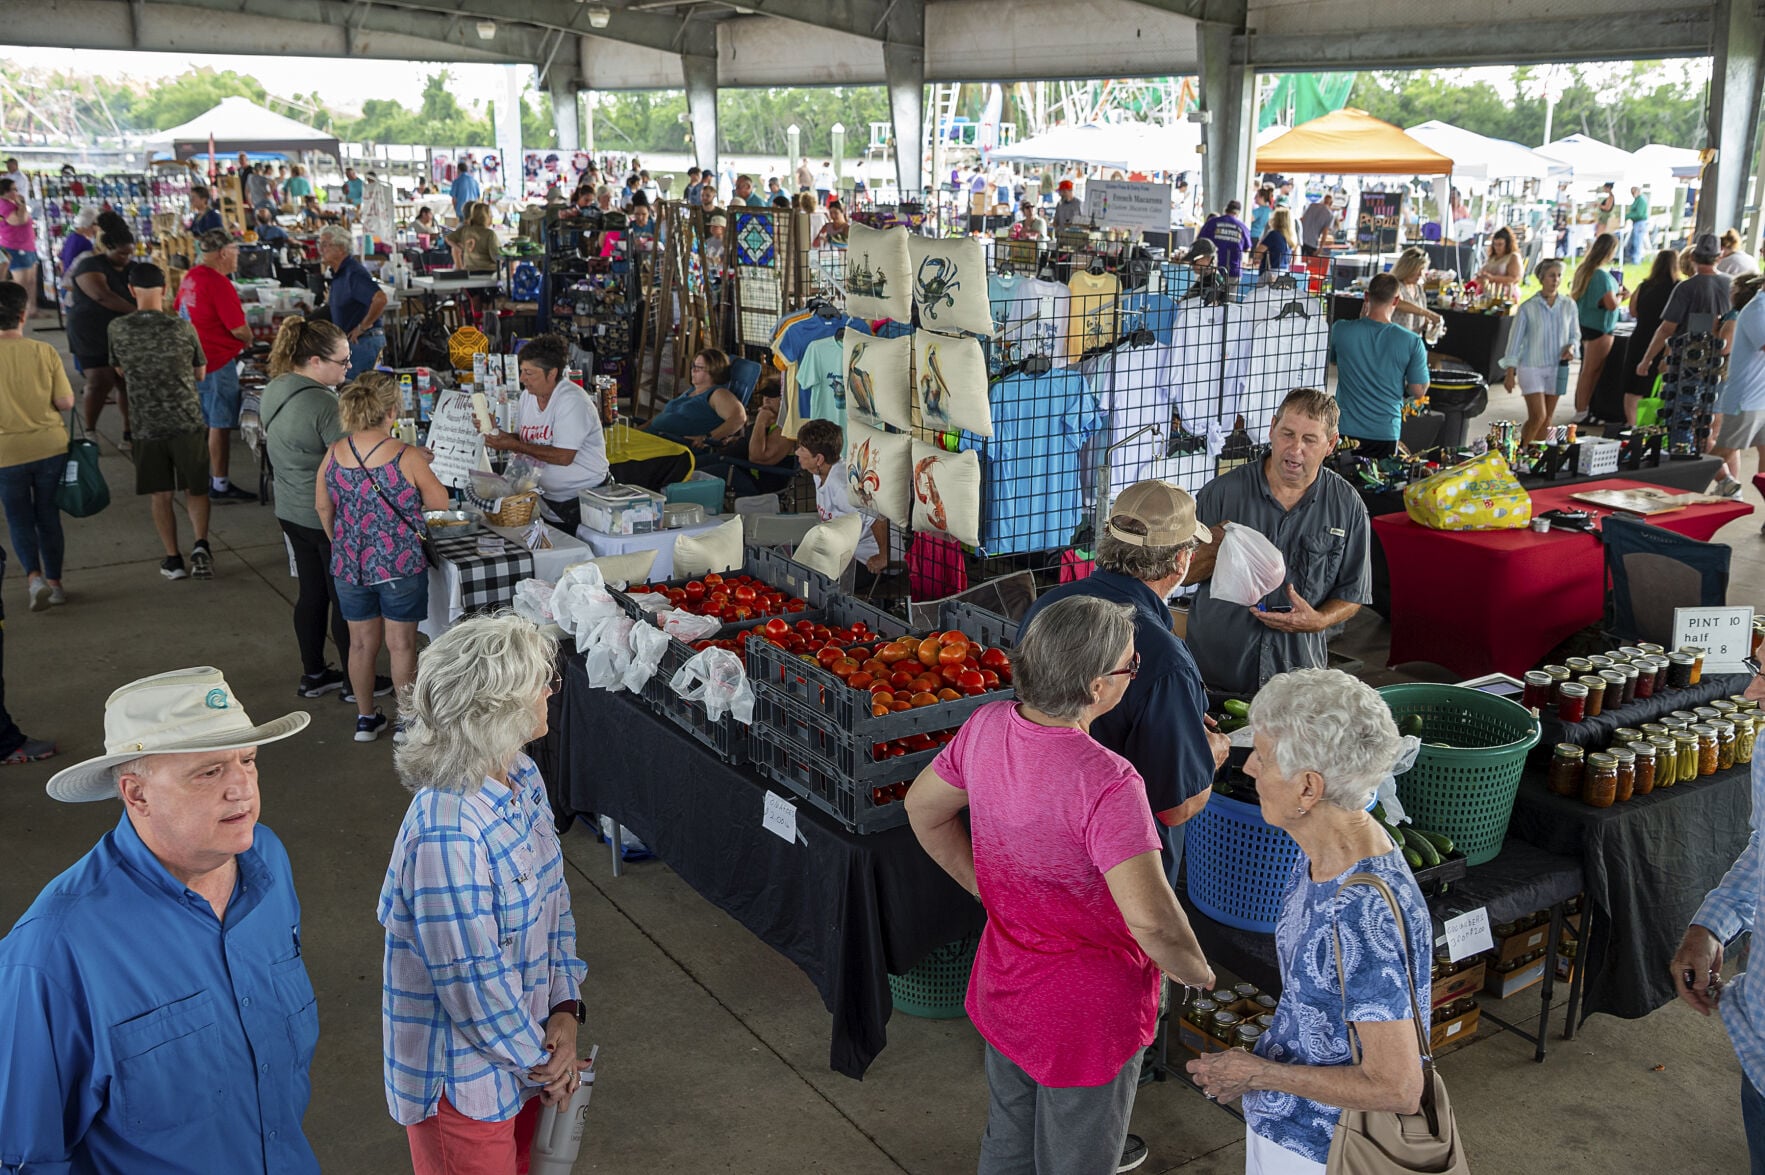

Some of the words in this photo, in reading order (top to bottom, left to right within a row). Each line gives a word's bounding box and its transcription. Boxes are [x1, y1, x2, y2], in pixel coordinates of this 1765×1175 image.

[1113, 193, 1132, 202] French
[1466, 480, 1511, 491] ROSS
[1689, 618, 1720, 628] PINT
[1730, 616, 1740, 626] 10
[1684, 633, 1710, 642] half
[1720, 644, 1728, 654] 8
